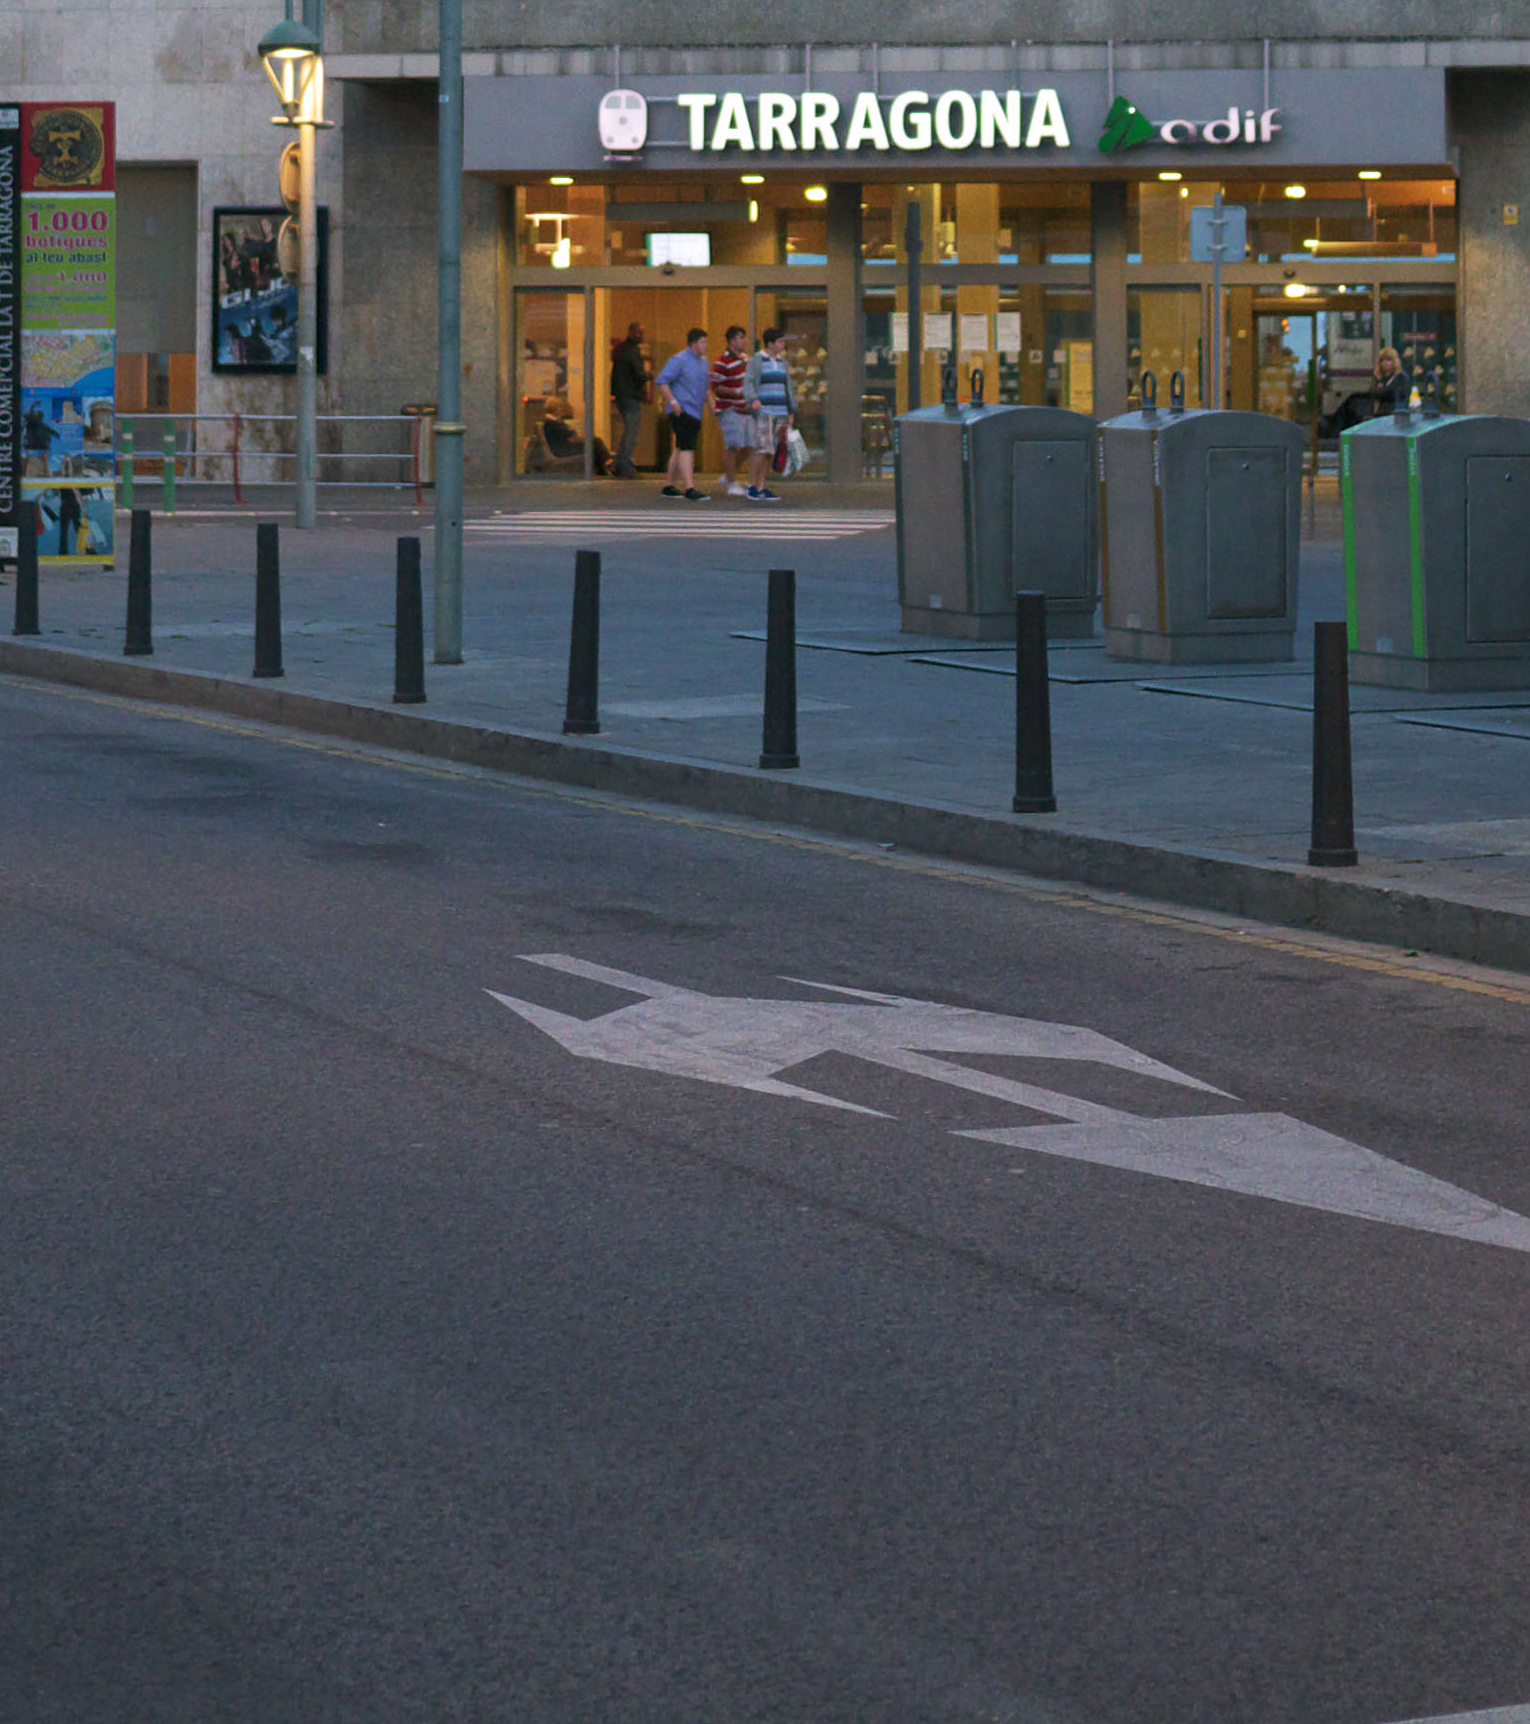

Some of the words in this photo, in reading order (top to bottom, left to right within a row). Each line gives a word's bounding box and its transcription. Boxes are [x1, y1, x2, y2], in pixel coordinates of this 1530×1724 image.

[677, 88, 1070, 152] TARRAGONA
[1160, 106, 1283, 145] adif
[26, 210, 108, 231] 1.000
[26, 235, 108, 251] botigues
